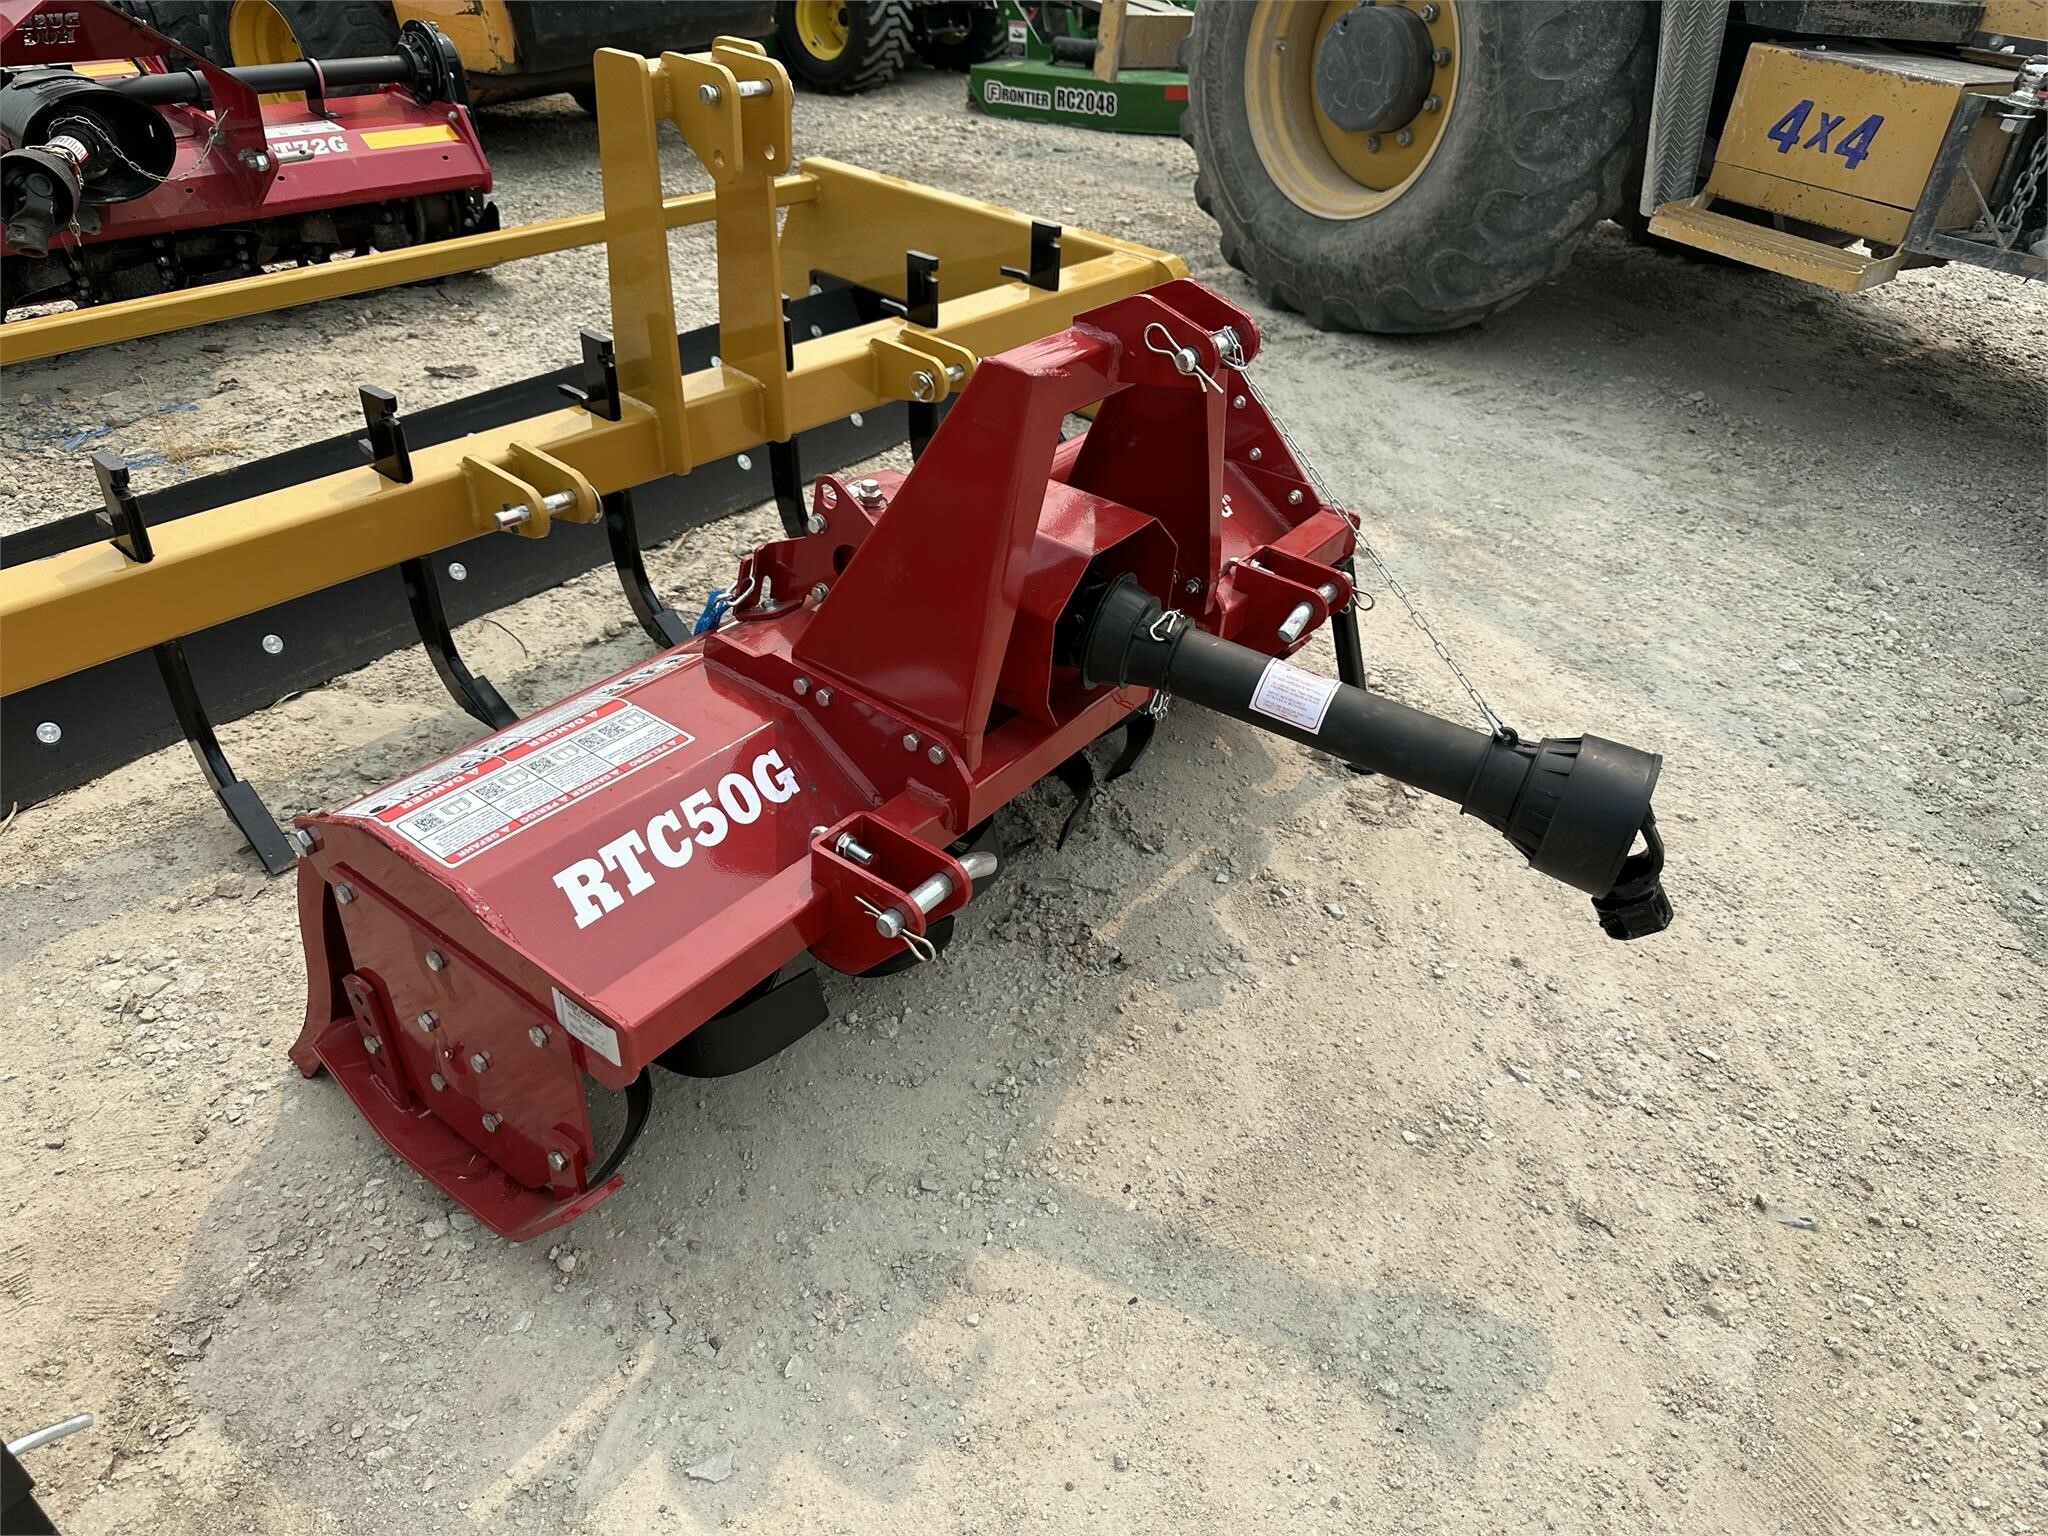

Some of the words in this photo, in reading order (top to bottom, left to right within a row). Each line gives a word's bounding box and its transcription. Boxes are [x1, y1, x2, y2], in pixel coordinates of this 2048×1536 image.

[986, 80, 1050, 108] FRONTIER
[1055, 87, 1117, 116] RC2048
[267, 136, 349, 156] T72G
[526, 717, 587, 747] DANGER
[400, 775, 466, 809] DANGER
[570, 775, 614, 798] DANGER
[456, 832, 500, 858] GEFAHR
[552, 749, 800, 929] RTC50G
